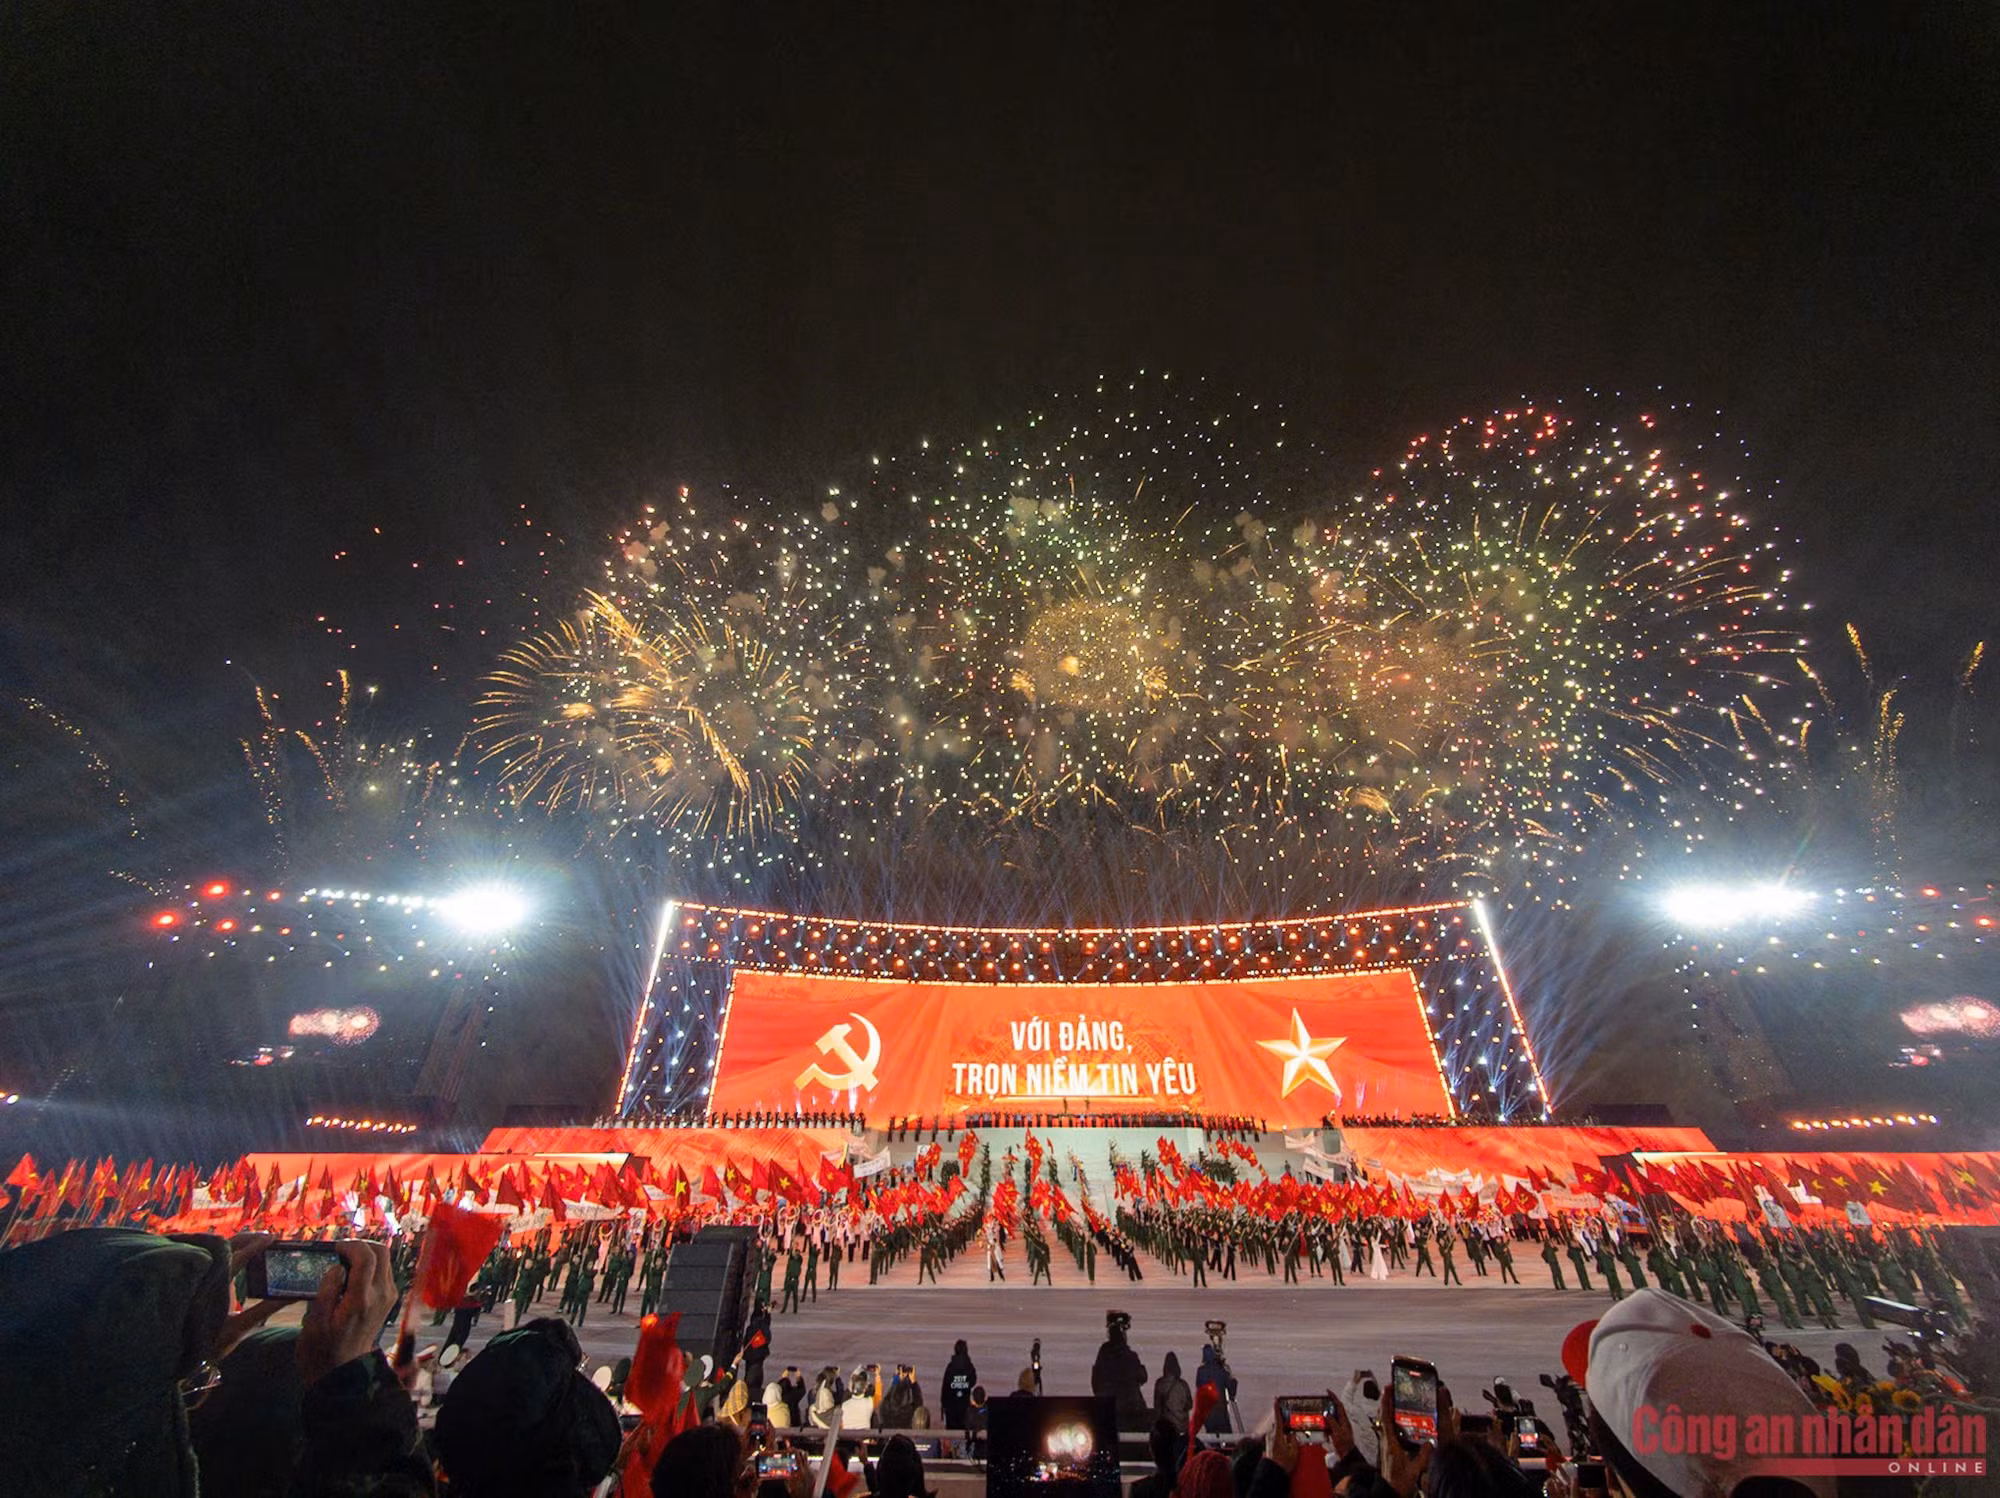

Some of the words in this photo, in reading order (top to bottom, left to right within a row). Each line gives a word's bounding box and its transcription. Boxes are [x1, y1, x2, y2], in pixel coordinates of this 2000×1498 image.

[1010, 1016, 1050, 1051] VỚI
[1059, 1014, 1133, 1054] ĐẢNG,
[952, 1063, 1017, 1100] TRỌN
[1026, 1056, 1089, 1095] NIỀM
[1097, 1063, 1138, 1095] TIN
[1145, 1057, 1197, 1095] YÊU
